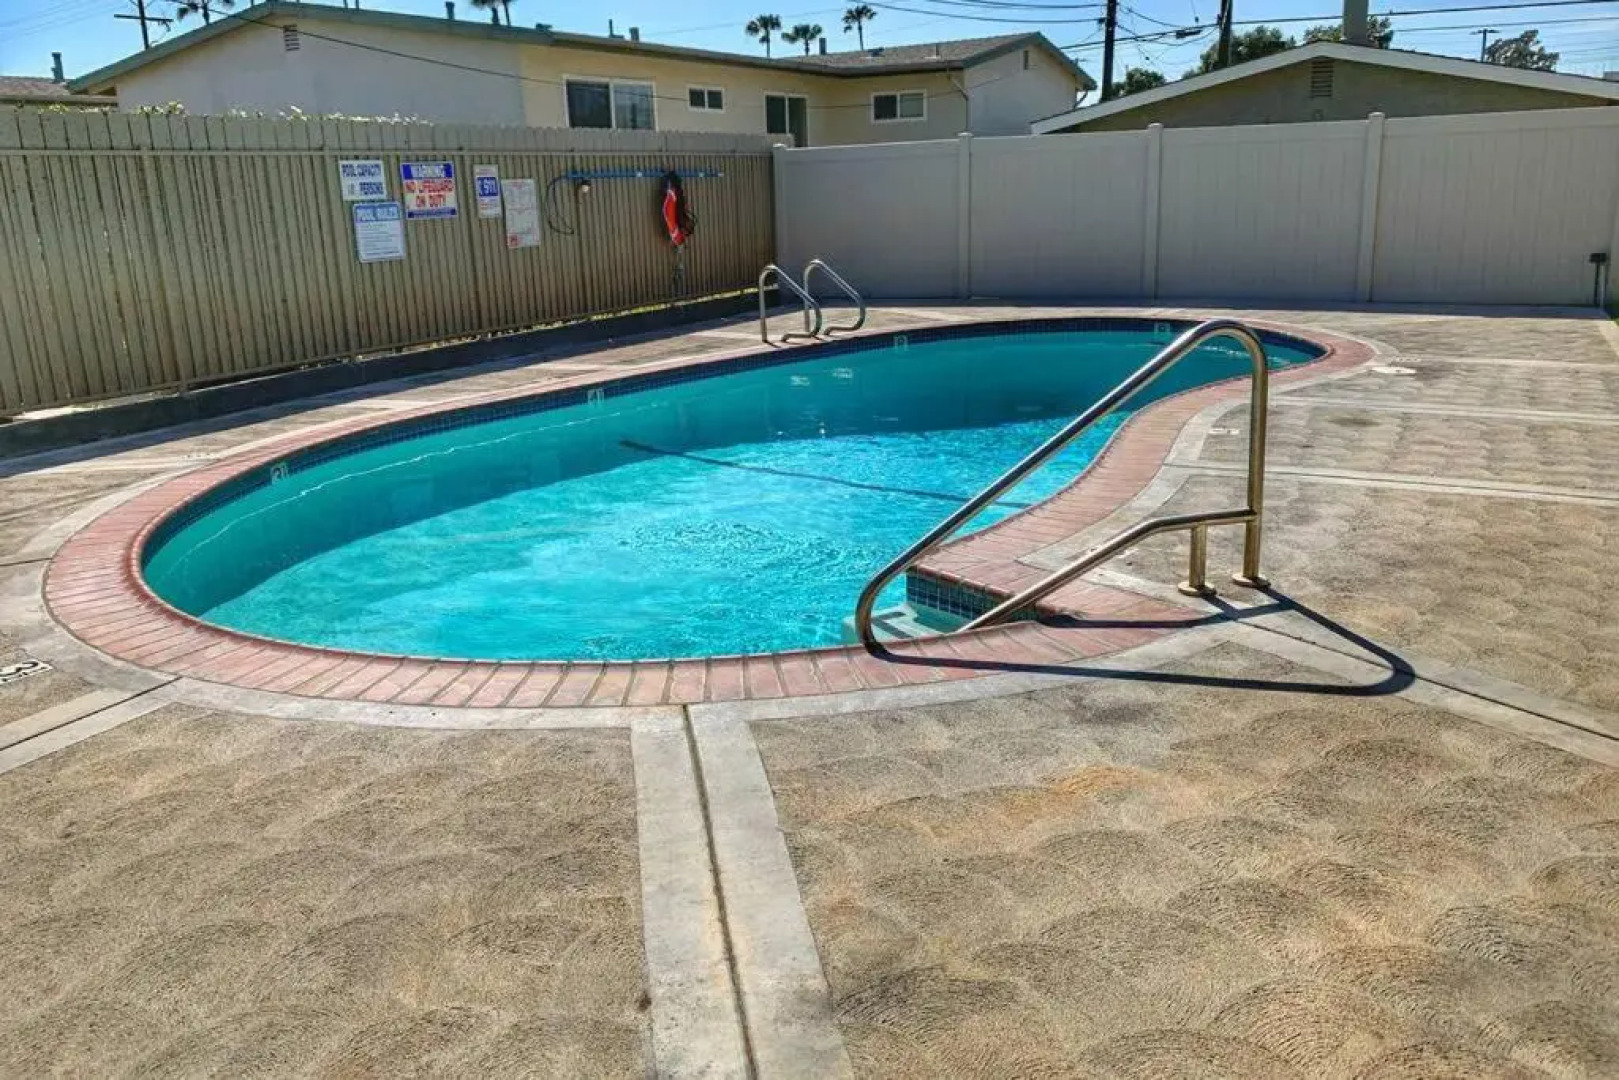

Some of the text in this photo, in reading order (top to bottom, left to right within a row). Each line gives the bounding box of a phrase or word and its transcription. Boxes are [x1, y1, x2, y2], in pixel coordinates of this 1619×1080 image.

[405, 179, 454, 193] NO LIFEGUARD
[415, 194, 446, 207] ON DUTY
